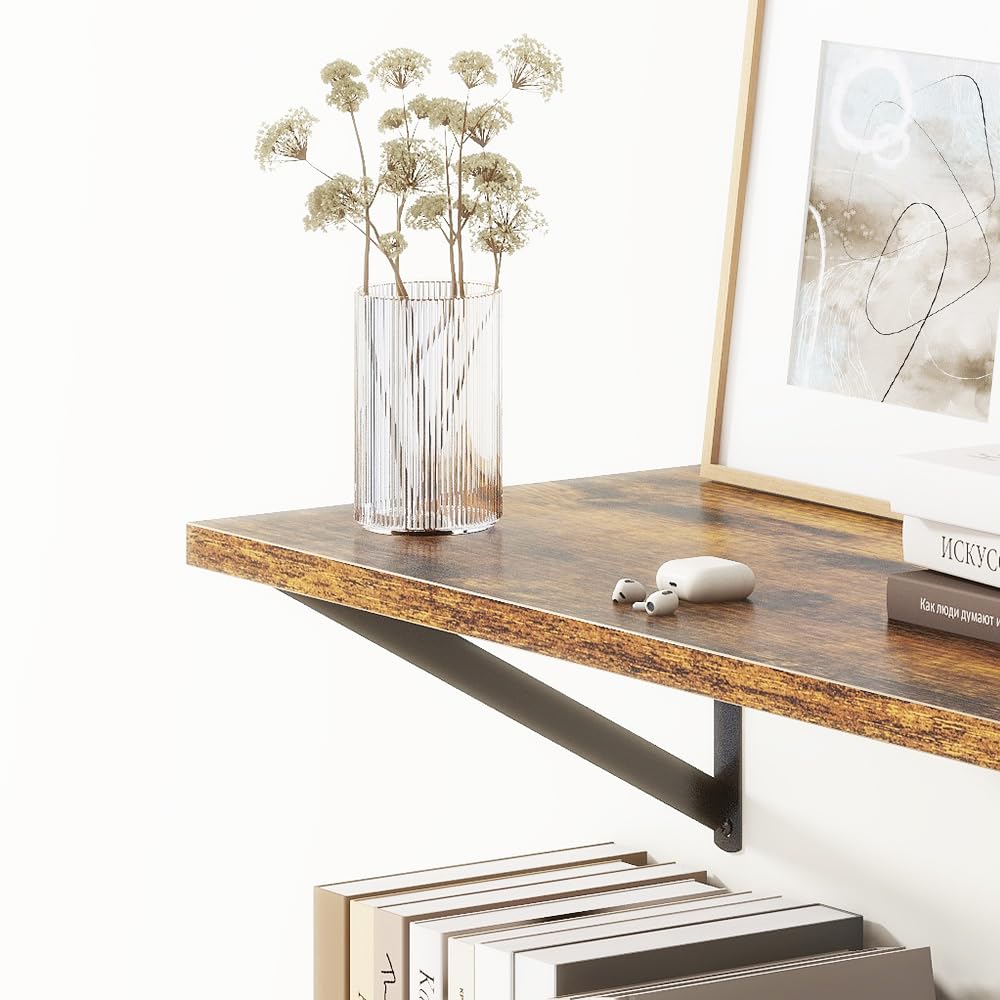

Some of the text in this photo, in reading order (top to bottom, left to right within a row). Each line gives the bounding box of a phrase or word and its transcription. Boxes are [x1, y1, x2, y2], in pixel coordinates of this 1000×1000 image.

[920, 597, 936, 614] Как
[936, 602, 960, 619] люди
[960, 609, 994, 628] думают
